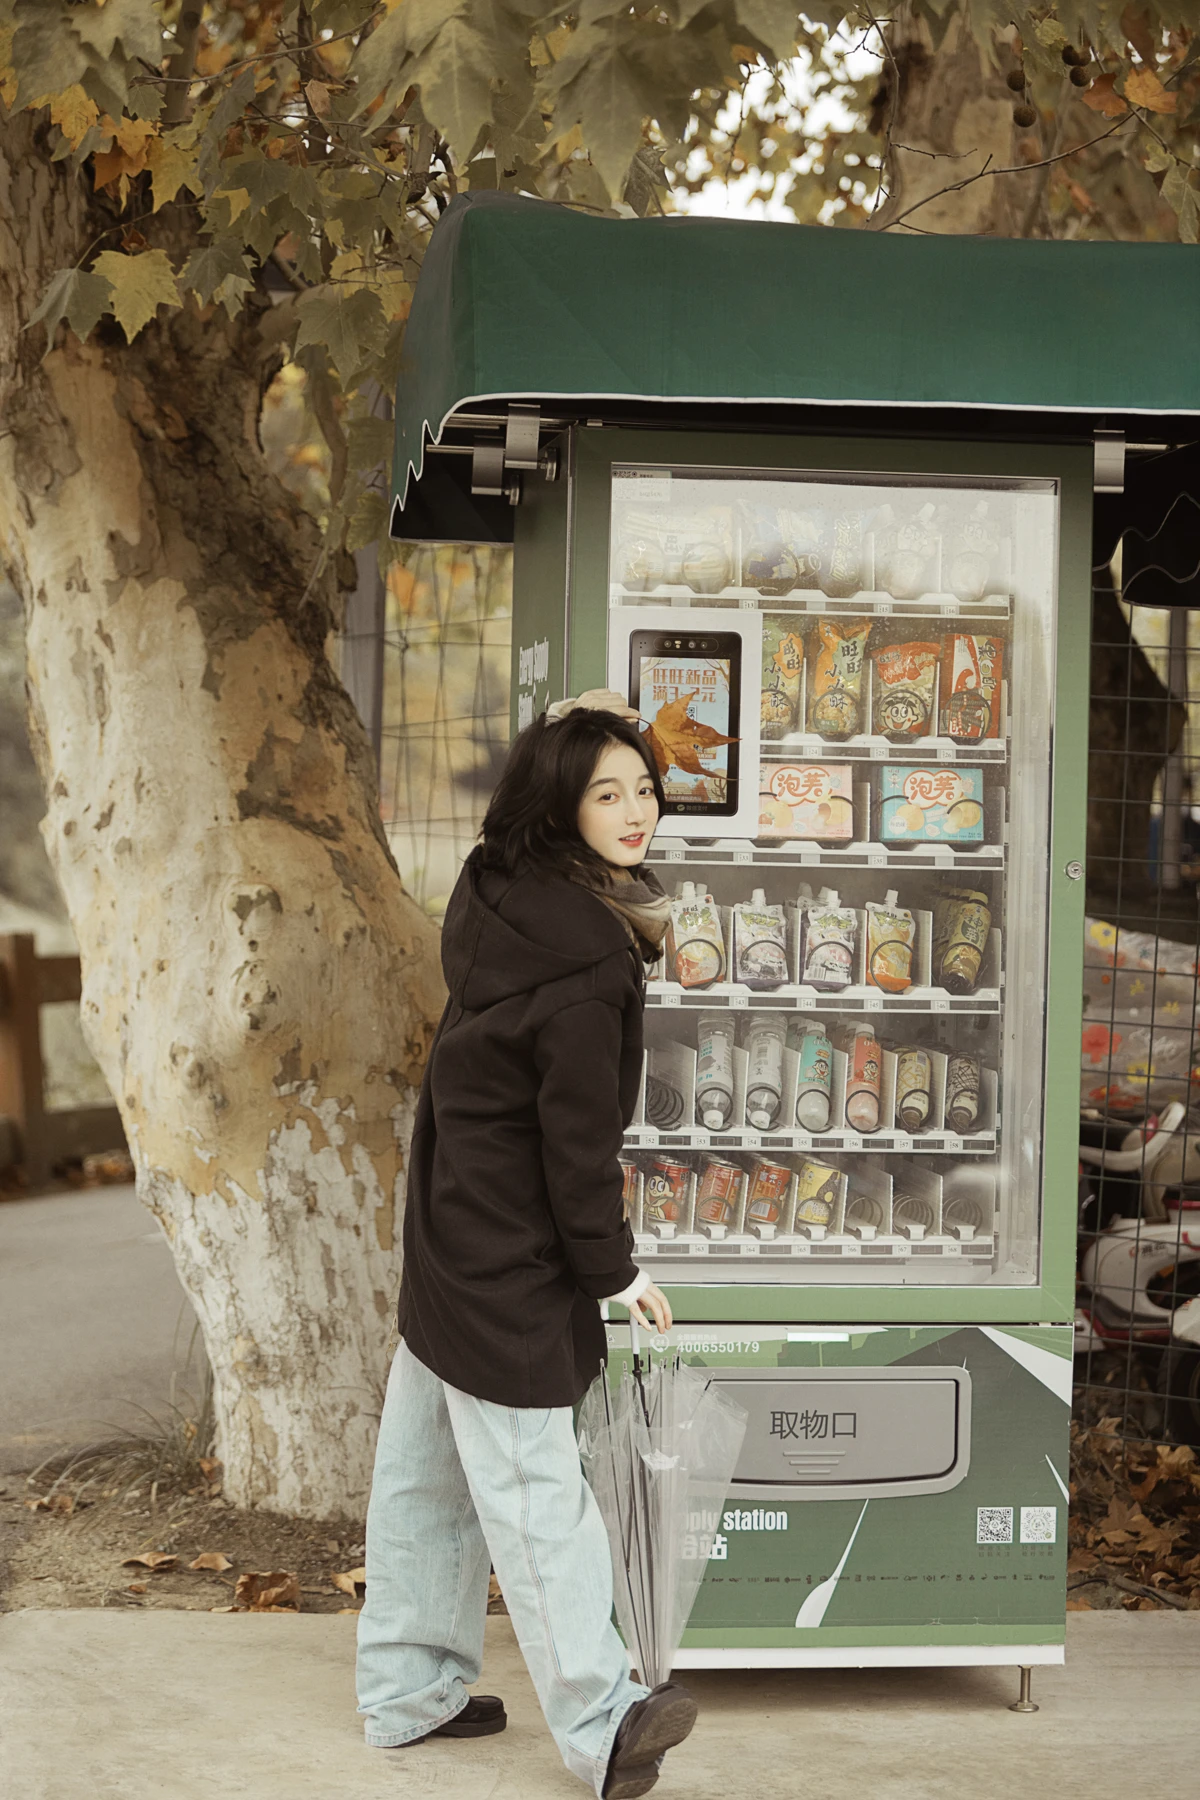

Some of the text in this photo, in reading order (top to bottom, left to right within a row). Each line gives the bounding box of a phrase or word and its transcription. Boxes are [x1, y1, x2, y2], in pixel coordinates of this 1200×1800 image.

[841, 641, 863, 673] 旺旺
[653, 668, 717, 685] 旺旺新品
[824, 663, 848, 710] 小小酥
[777, 772, 826, 797] 泡芙
[909, 776, 957, 800] 泡芙
[677, 1341, 760, 1353] 4006550179
[770, 1409, 857, 1440] 取物口
[723, 1508, 788, 1531] station
